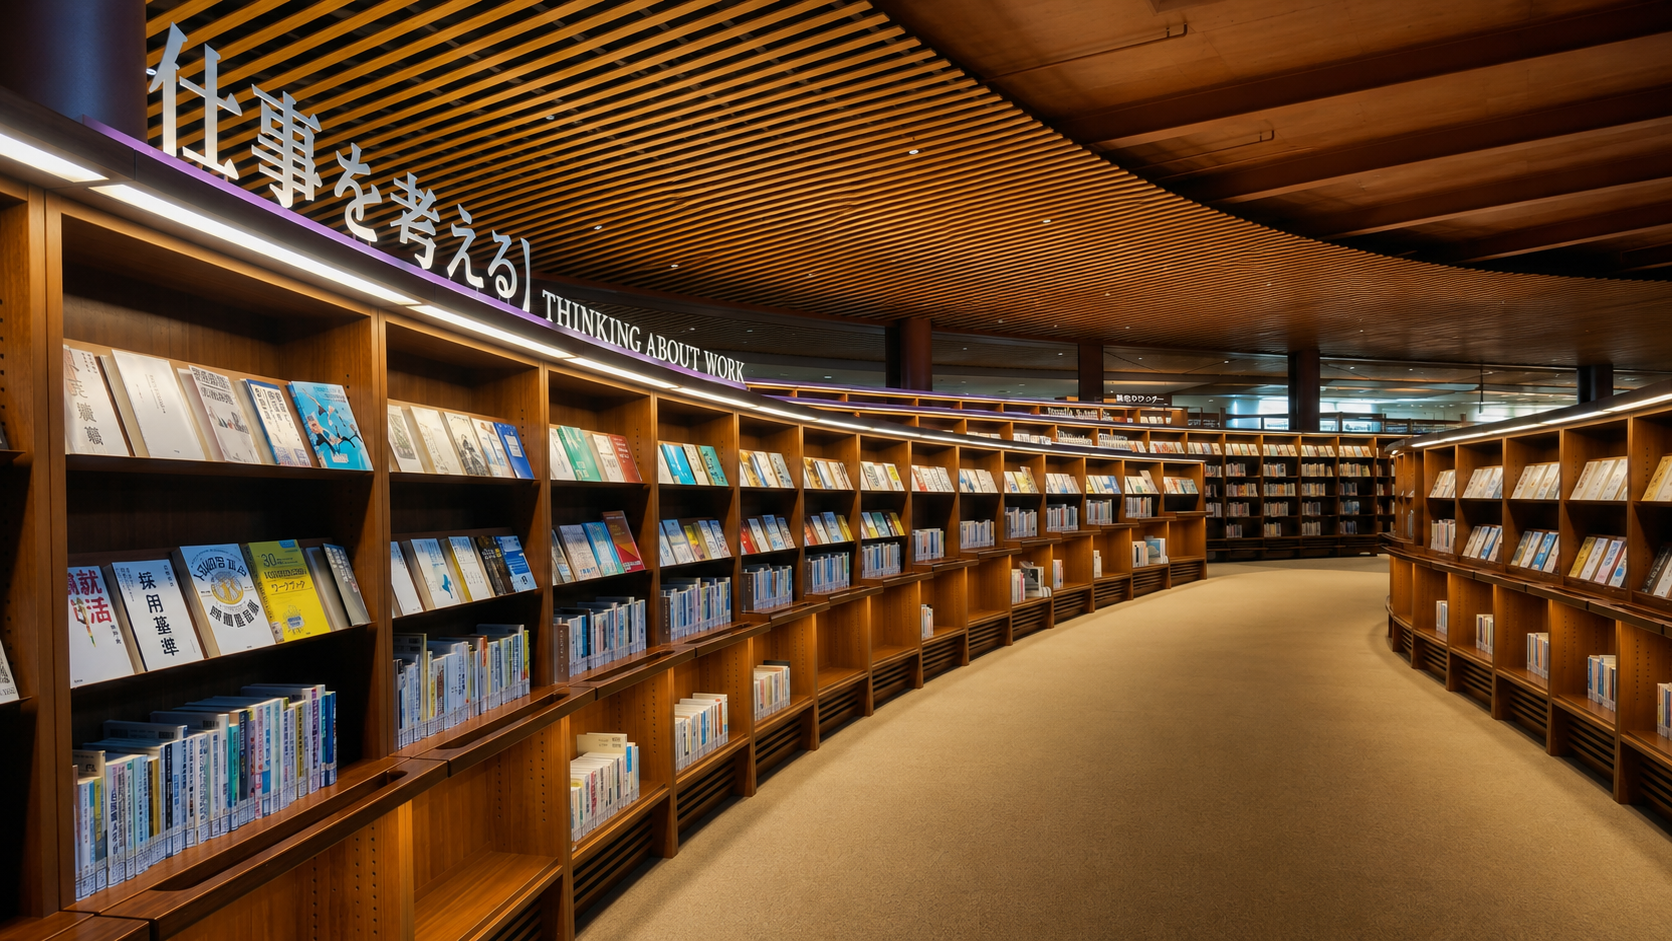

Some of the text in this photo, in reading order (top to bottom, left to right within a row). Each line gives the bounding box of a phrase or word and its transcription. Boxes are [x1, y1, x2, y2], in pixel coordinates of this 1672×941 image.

[149, 22, 518, 298] 仕事を考える
[542, 289, 745, 384] THINKING ABOUT WORK
